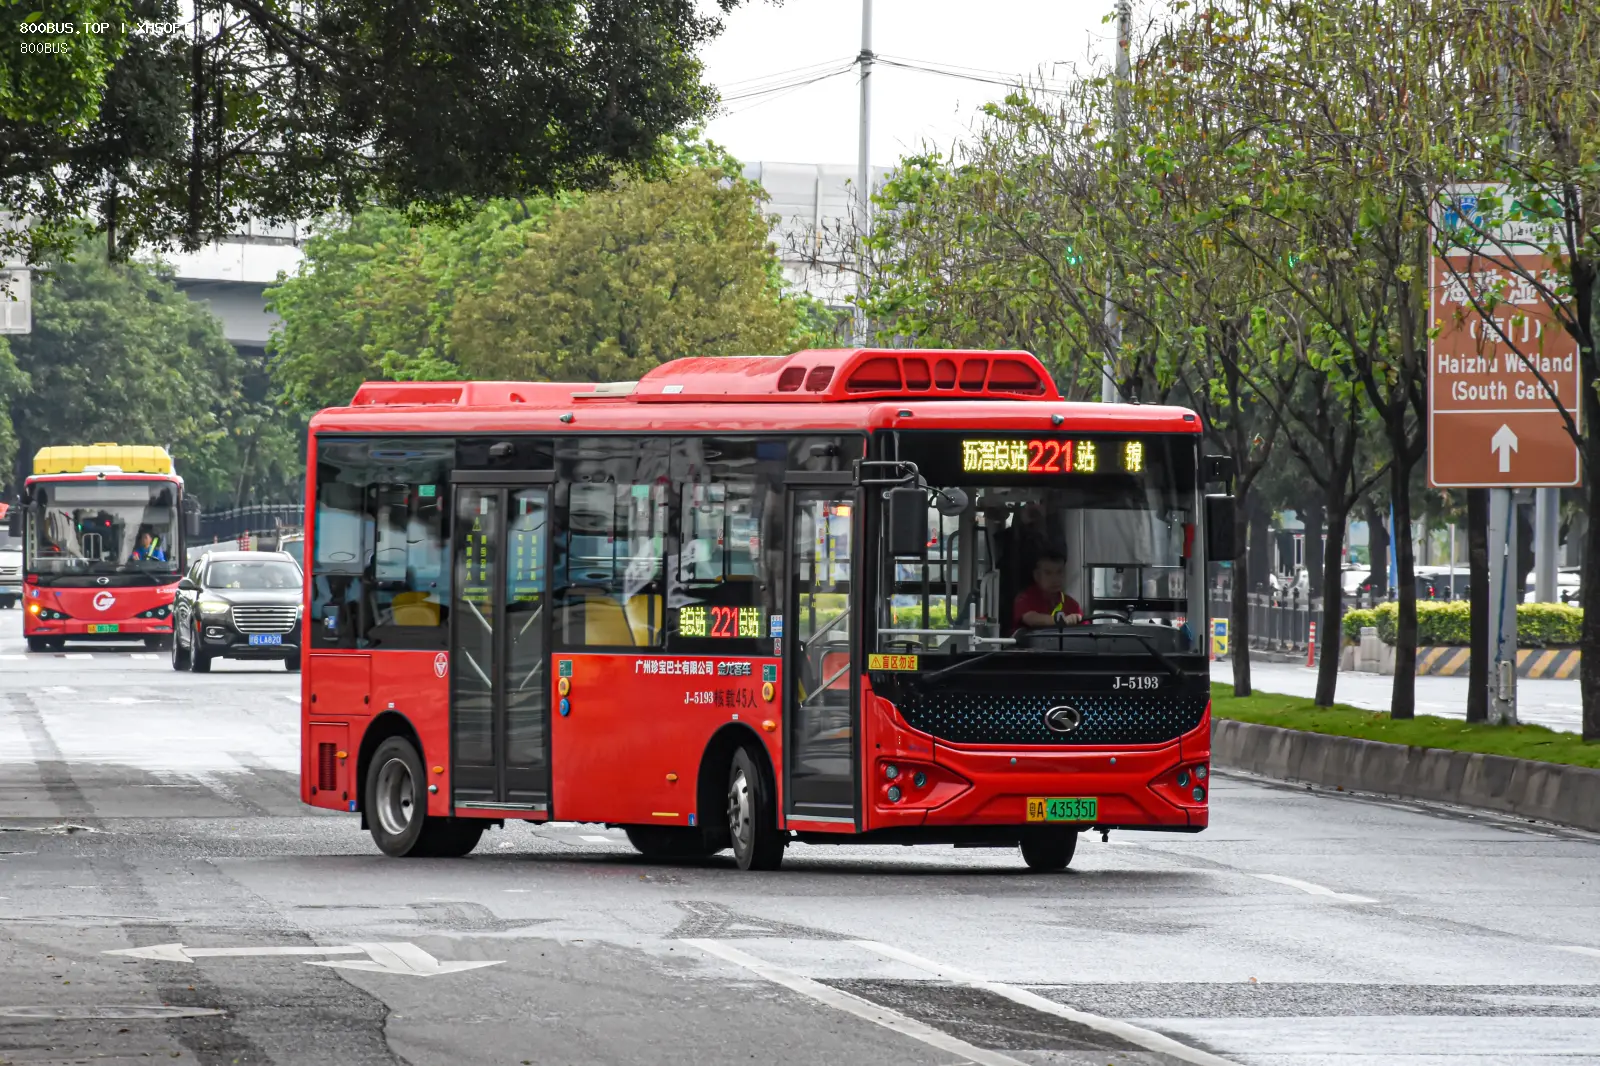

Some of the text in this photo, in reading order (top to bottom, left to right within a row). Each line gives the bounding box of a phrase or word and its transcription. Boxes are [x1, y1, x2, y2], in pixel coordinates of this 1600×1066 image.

[1438, 353, 1573, 374] Haizhu Wetland
[1452, 380, 1507, 400] (South
[1028, 440, 1073, 472] 221
[711, 606, 739, 637] 221
[635, 659, 714, 675] 广州珍宝巴士有限公司
[1112, 676, 1159, 689] J-5193
[684, 691, 714, 704] J-5193
